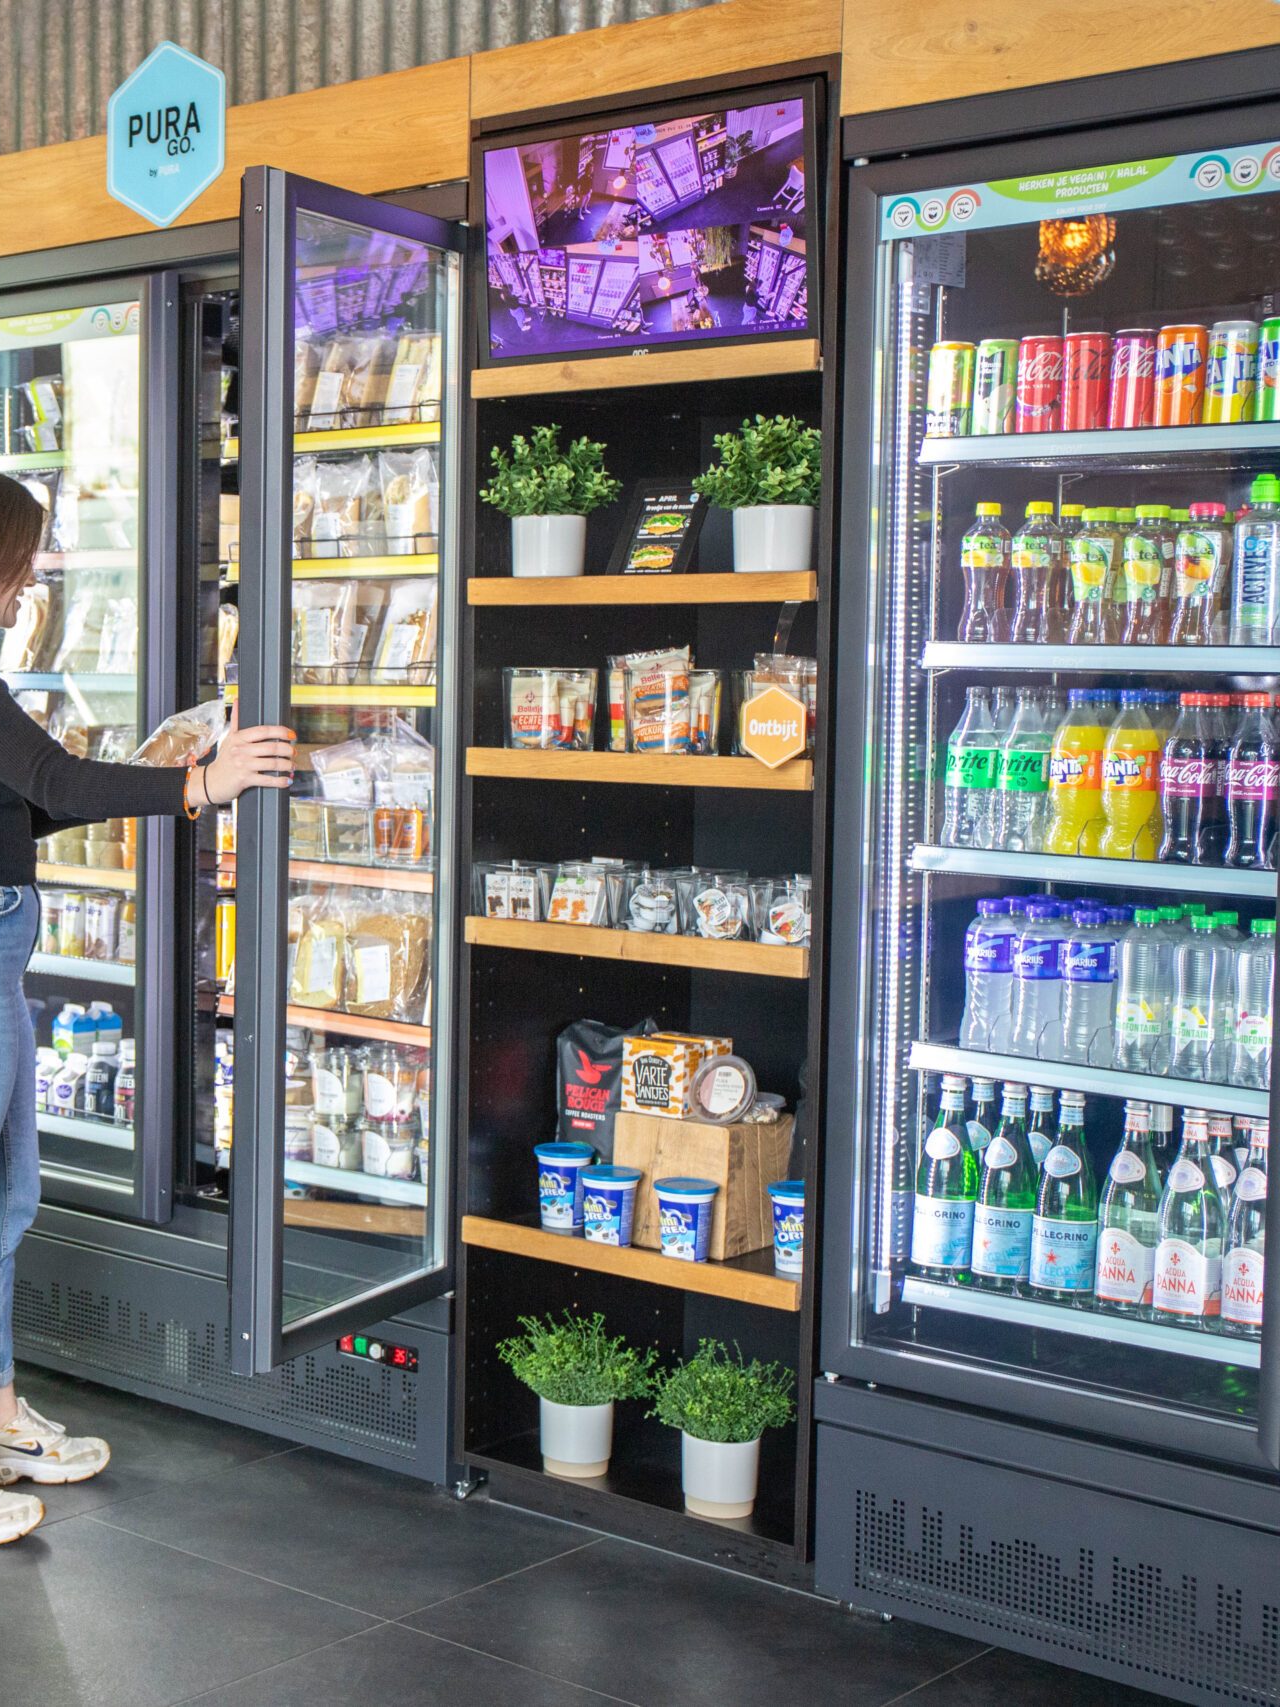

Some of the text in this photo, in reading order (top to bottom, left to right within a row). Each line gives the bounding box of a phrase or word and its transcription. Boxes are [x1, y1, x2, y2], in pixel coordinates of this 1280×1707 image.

[128, 101, 201, 148] PURA
[167, 136, 195, 156] GO.
[1018, 178, 1055, 192] HERKEN
[1056, 176, 1068, 187] JE
[1116, 165, 1149, 178] HALAL
[1055, 182, 1109, 198] PRODUCTEN
[1243, 552, 1267, 605] ACTIVE
[749, 719, 799, 742] Ontbijt
[635, 1061, 668, 1087] VARIE
[565, 1083, 610, 1101] PELICAN
[636, 1083, 669, 1101] JANTJES
[567, 1095, 605, 1113] ROUGE
[565, 1109, 606, 1121] COFFEE ROASTERS
[660, 1225, 688, 1235] REO
[781, 1222, 804, 1232] Min
[1105, 1256, 1126, 1267] ACQUA
[1097, 1262, 1136, 1284] PANNA
[1165, 1267, 1187, 1278] ACQUA
[1157, 1273, 1197, 1295] PANNA
[1233, 1277, 1256, 1288] ACQUA
